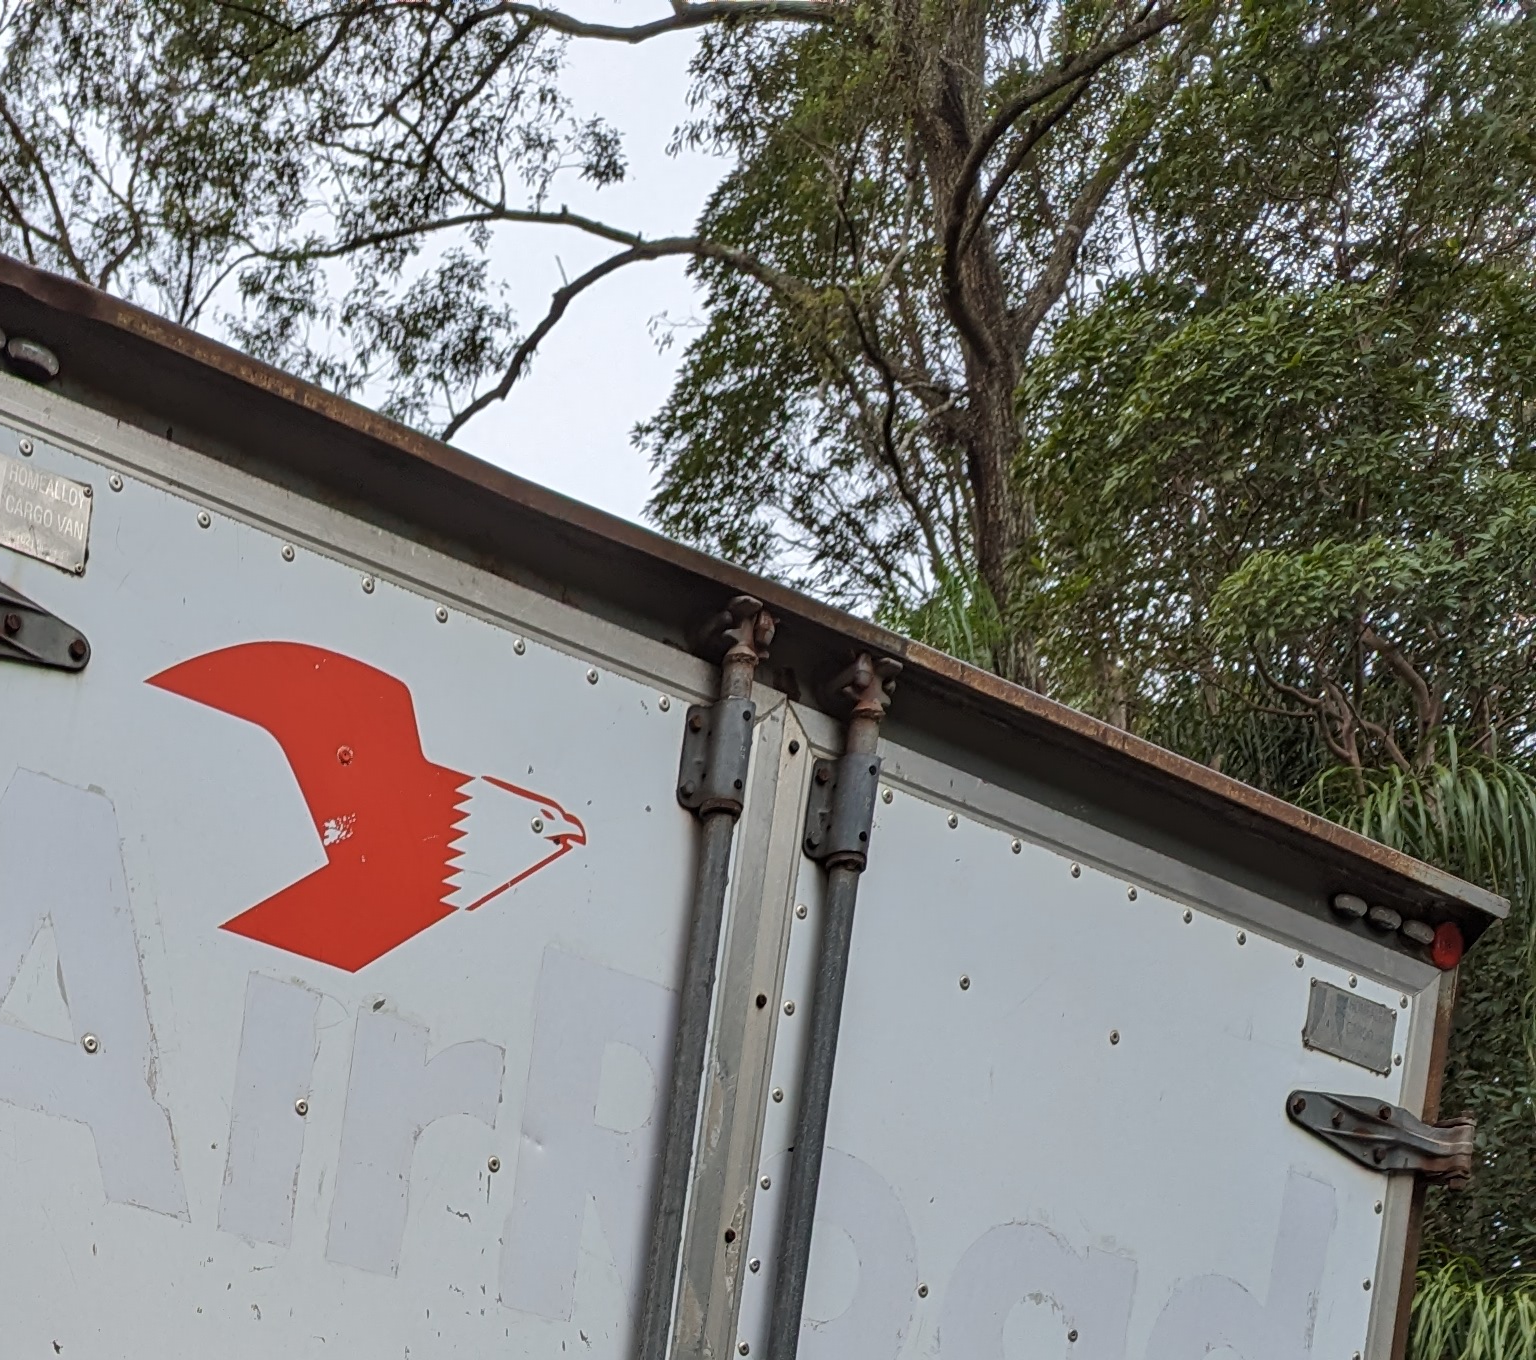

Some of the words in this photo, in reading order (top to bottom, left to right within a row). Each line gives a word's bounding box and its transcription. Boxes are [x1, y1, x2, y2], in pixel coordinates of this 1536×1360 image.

[9, 462, 84, 509] HOMEALLOY
[5, 496, 52, 528] CARGO
[57, 515, 84, 540] VAN
